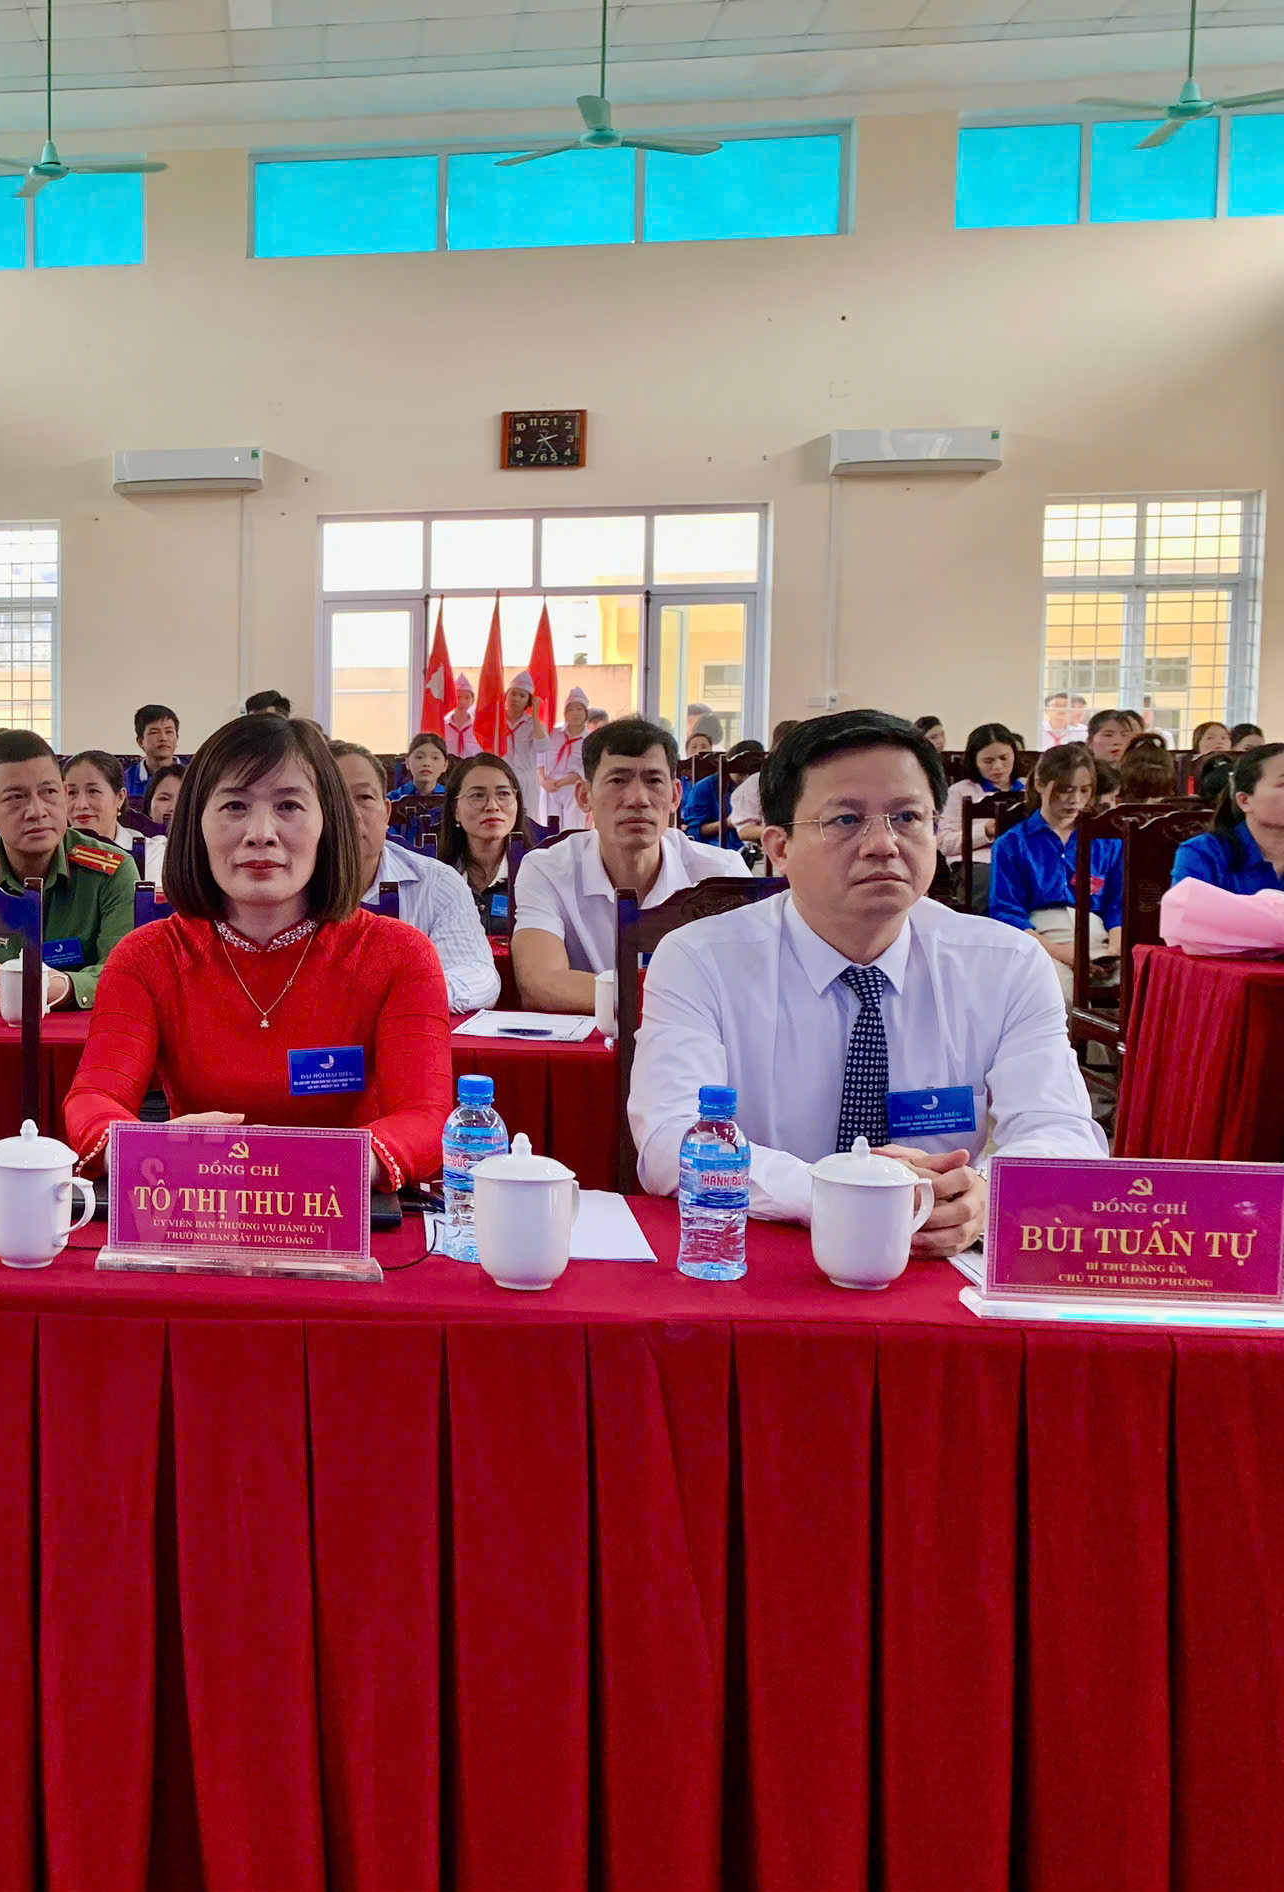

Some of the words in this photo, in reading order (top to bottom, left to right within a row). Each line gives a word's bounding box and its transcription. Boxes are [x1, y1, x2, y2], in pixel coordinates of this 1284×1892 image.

[540, 417, 550, 426] 12
[564, 421, 572, 429] 2
[516, 422, 526, 431] 10
[514, 436, 521, 444] 9
[566, 434, 574, 442] 3
[516, 450, 524, 458] 8
[564, 448, 571, 456] 4
[529, 453, 537, 462] 7
[540, 453, 547, 461] 6
[550, 453, 558, 461] 5
[197, 1160, 245, 1176] ĐỒNG
[249, 1164, 279, 1177] CHÍ
[700, 1174, 730, 1186] THANH
[134, 1179, 171, 1211] TÔ
[178, 1187, 229, 1219] THỊ
[235, 1190, 294, 1216] THU
[303, 1185, 343, 1218] HÀ
[1153, 1201, 1187, 1215] CHÍ
[168, 1218, 193, 1227] VIÊN
[195, 1220, 215, 1229] BAN
[262, 1223, 276, 1233] VỤ
[210, 1232, 232, 1241] BAN
[233, 1232, 252, 1242] XÂY
[254, 1234, 283, 1244] DỰNG
[1019, 1217, 1084, 1253] BÙI
[1094, 1218, 1196, 1257] TUẤN
[1205, 1229, 1258, 1266] TỰ
[1058, 1272, 1084, 1282] CHỦ
[1088, 1274, 1117, 1284] TỊCH
